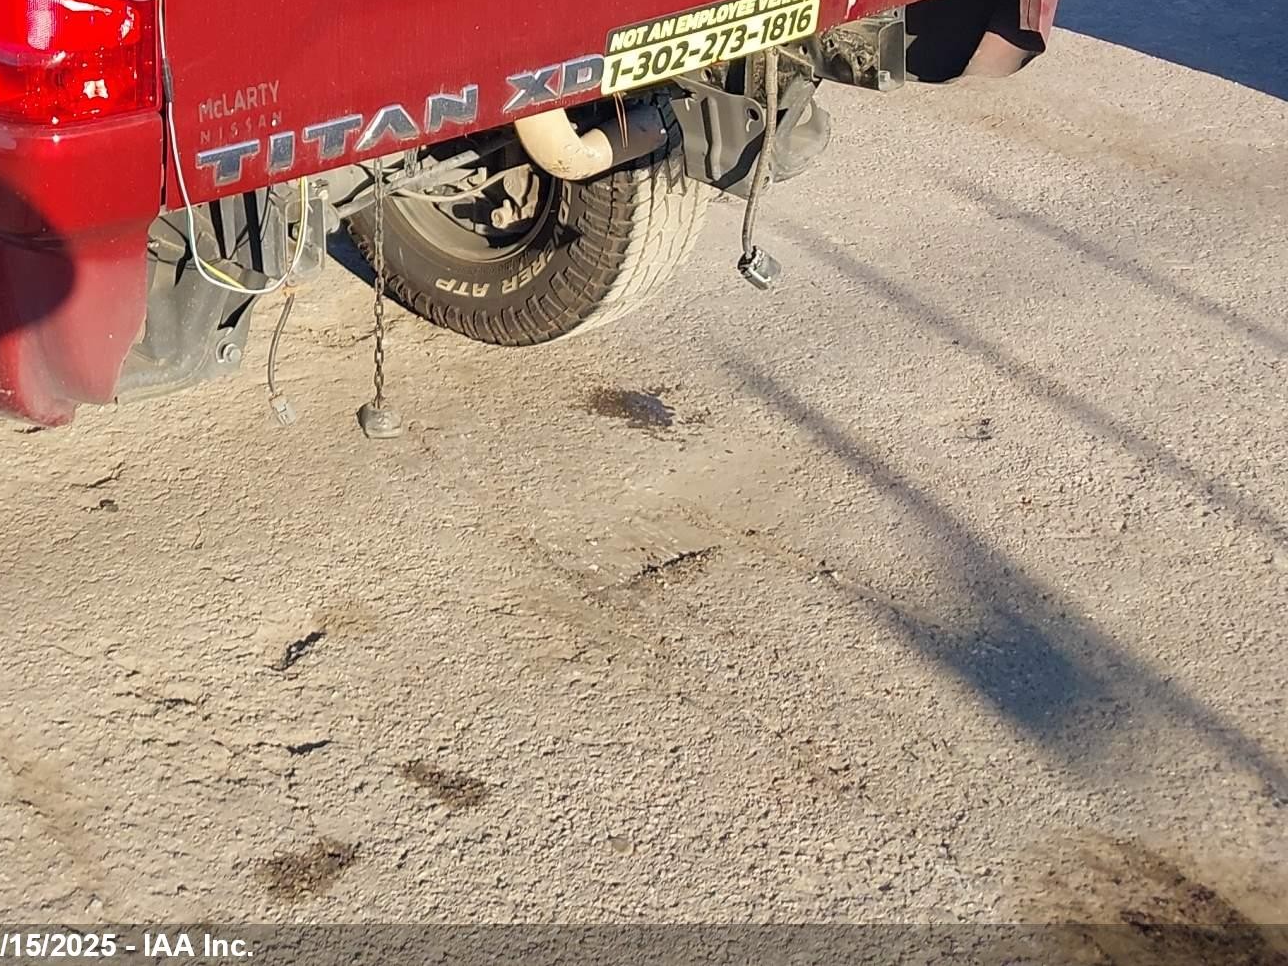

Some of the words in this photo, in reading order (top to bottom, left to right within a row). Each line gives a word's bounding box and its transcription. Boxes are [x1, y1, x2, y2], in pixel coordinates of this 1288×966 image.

[609, 4, 813, 88] 1-302-273-1816
[610, 29, 648, 52] NOT
[646, 18, 676, 41] AN
[195, 83, 479, 187] TITAN
[502, 53, 605, 114] XD
[198, 79, 279, 123] McLARTY
[200, 111, 282, 145] NISSAN
[434, 277, 490, 298] ATP
